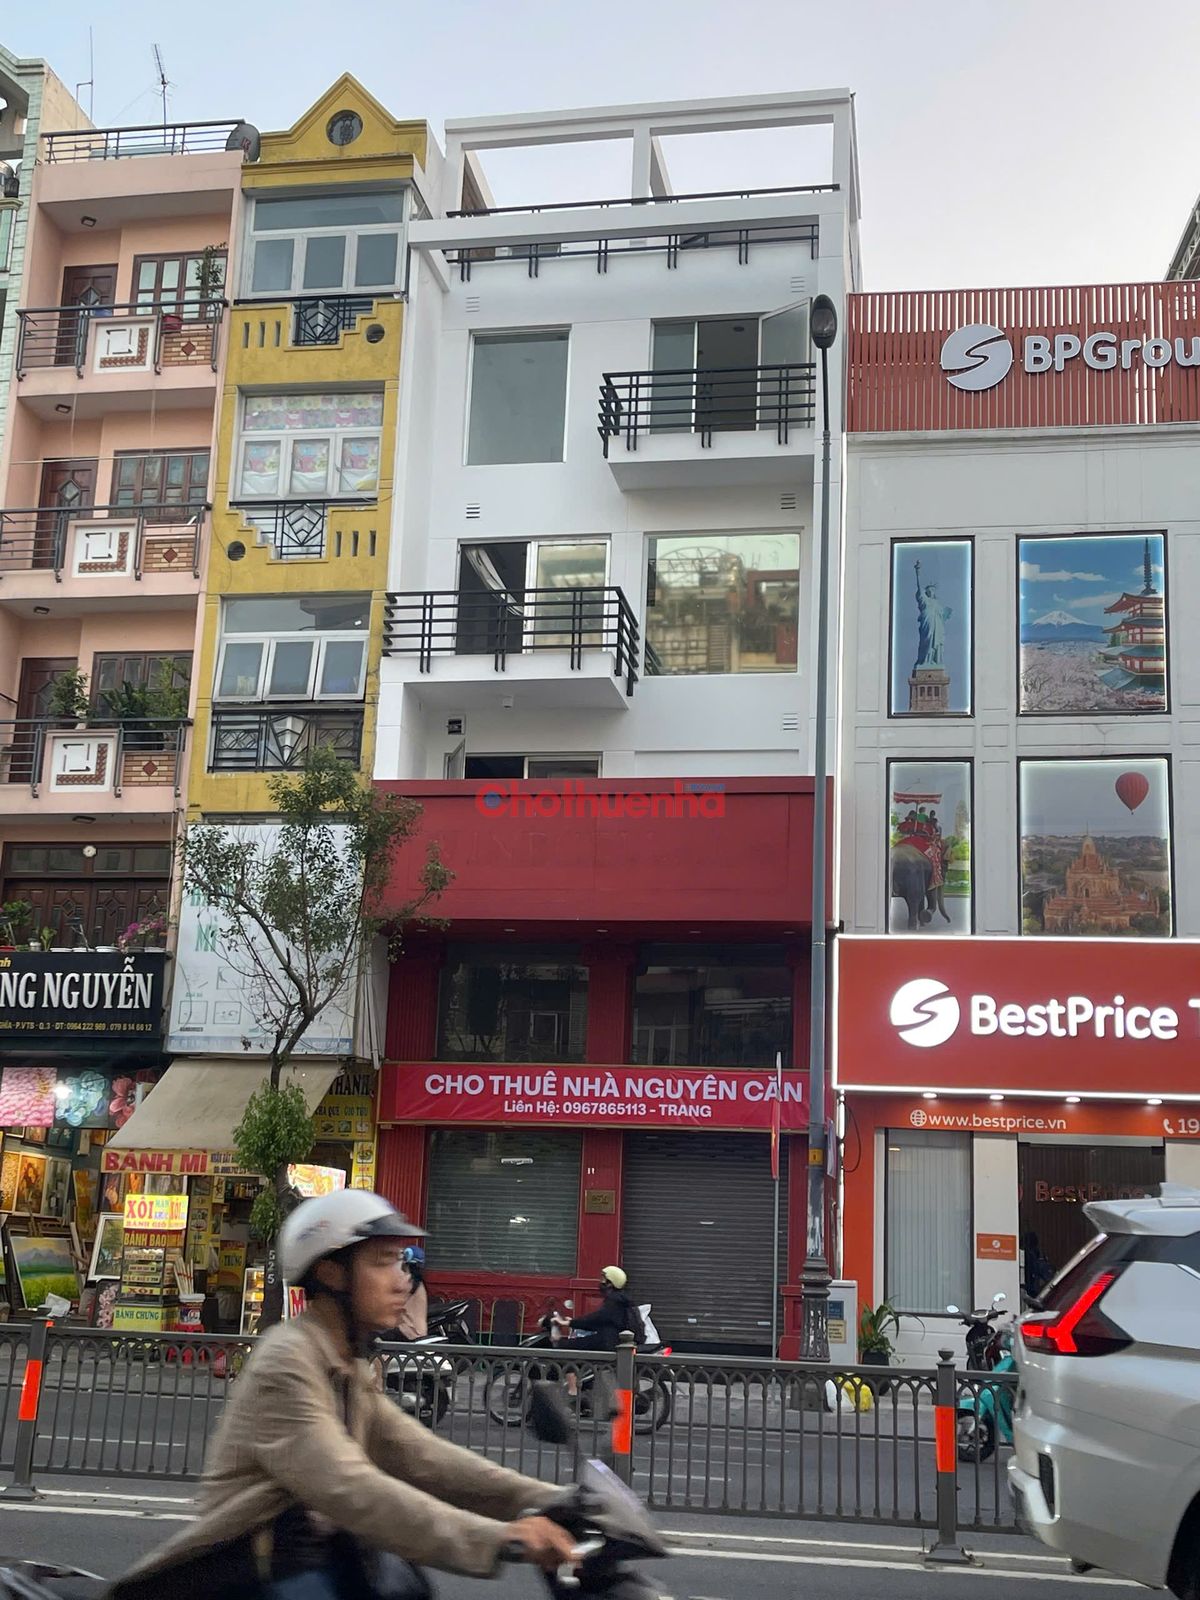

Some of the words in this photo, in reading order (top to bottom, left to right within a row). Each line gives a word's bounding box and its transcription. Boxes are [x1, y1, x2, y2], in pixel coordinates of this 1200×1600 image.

[1024, 332, 1200, 374] BPGrou
[0, 972, 37, 1009] NG
[41, 956, 154, 1009] NGUYỄN
[970, 995, 1179, 1040] BestPrice
[425, 1074, 485, 1095] CHO
[489, 1070, 557, 1096] THUÊ
[563, 1072, 620, 1097] NHÀ
[625, 1074, 738, 1100] NGUYÊN
[743, 1076, 802, 1102] CĂN
[504, 1100, 533, 1113] Liên
[536, 1101, 560, 1116] Hệ:
[563, 1102, 647, 1115] 0967865113
[659, 1104, 712, 1117] TRANG
[929, 1113, 1067, 1131] www.bestprice.vn
[1178, 1119, 1200, 1134] 19
[105, 1150, 173, 1172] BÁNH
[180, 1150, 208, 1173] MÌ
[127, 1196, 154, 1219] XÔI
